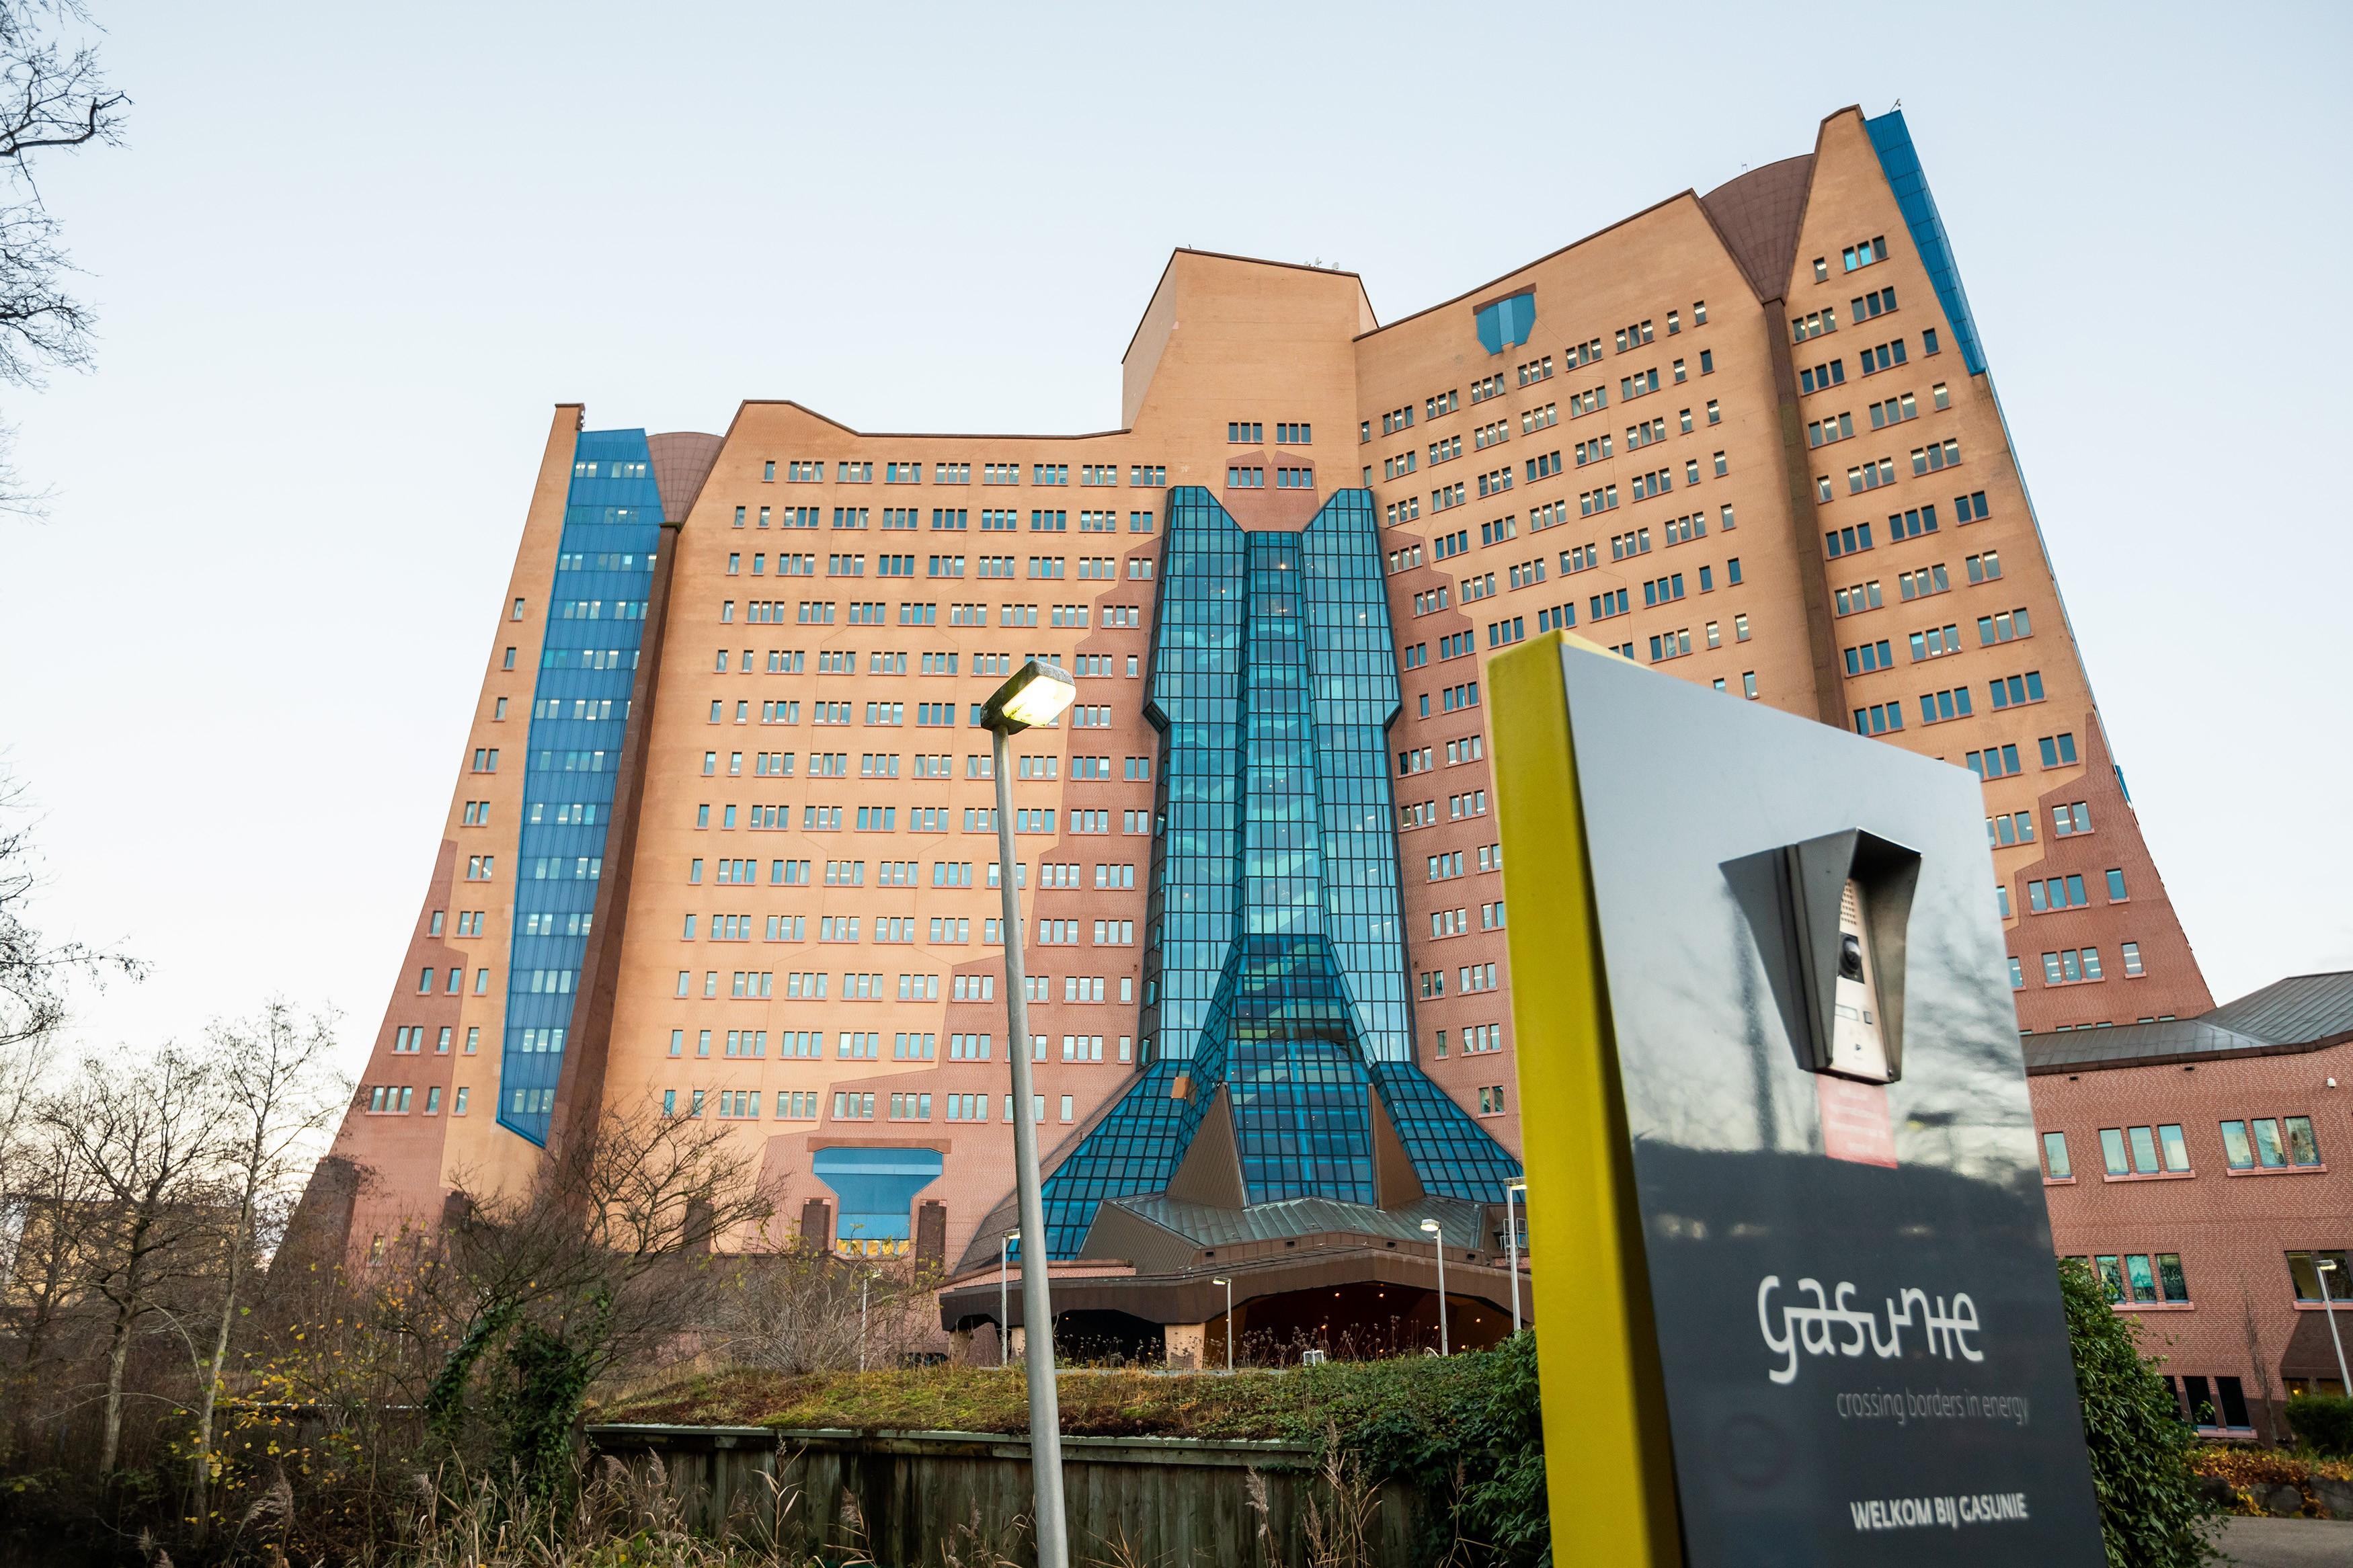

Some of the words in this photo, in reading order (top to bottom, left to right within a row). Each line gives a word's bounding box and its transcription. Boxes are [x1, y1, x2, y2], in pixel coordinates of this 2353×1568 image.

[1757, 1275, 1984, 1385] gasunie
[1837, 1387, 1905, 1425] crossing
[1905, 1387, 1964, 1416] borders
[1964, 1388, 1980, 1416] in
[1983, 1395, 2028, 1425] energy
[1850, 1497, 1933, 1530] WELKOM
[1933, 1496, 1958, 1530] BIJ
[1958, 1492, 2028, 1522] GASUNIE
